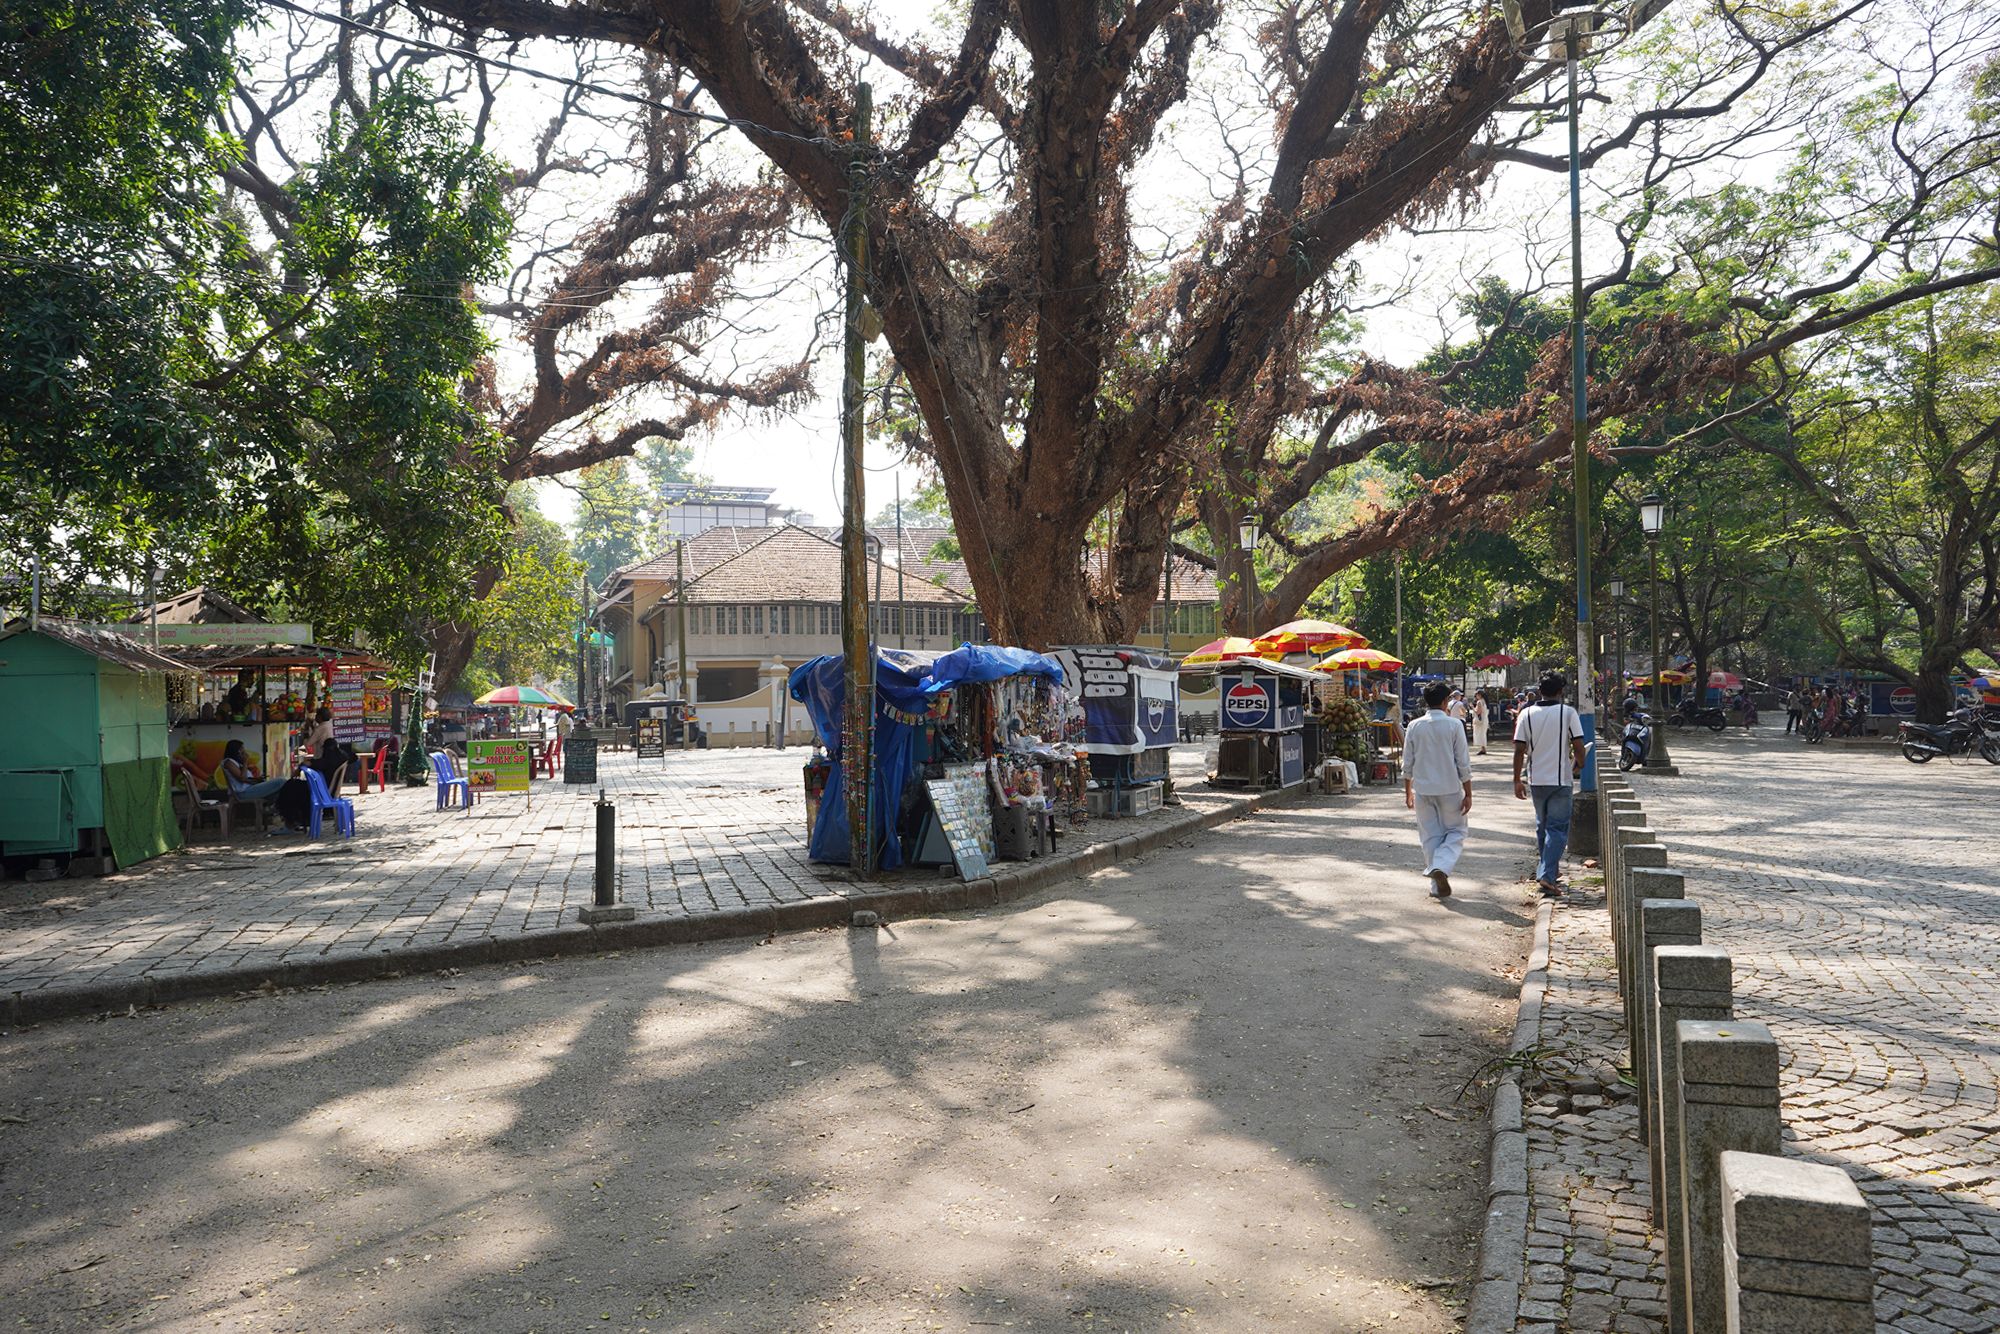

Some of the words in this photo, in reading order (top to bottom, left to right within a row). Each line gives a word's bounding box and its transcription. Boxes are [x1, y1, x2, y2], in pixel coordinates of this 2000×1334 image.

[1228, 698, 1267, 709] PEPSI
[495, 745, 516, 754] AVIL
[486, 755, 510, 764] MILK
[513, 755, 526, 763] SP
